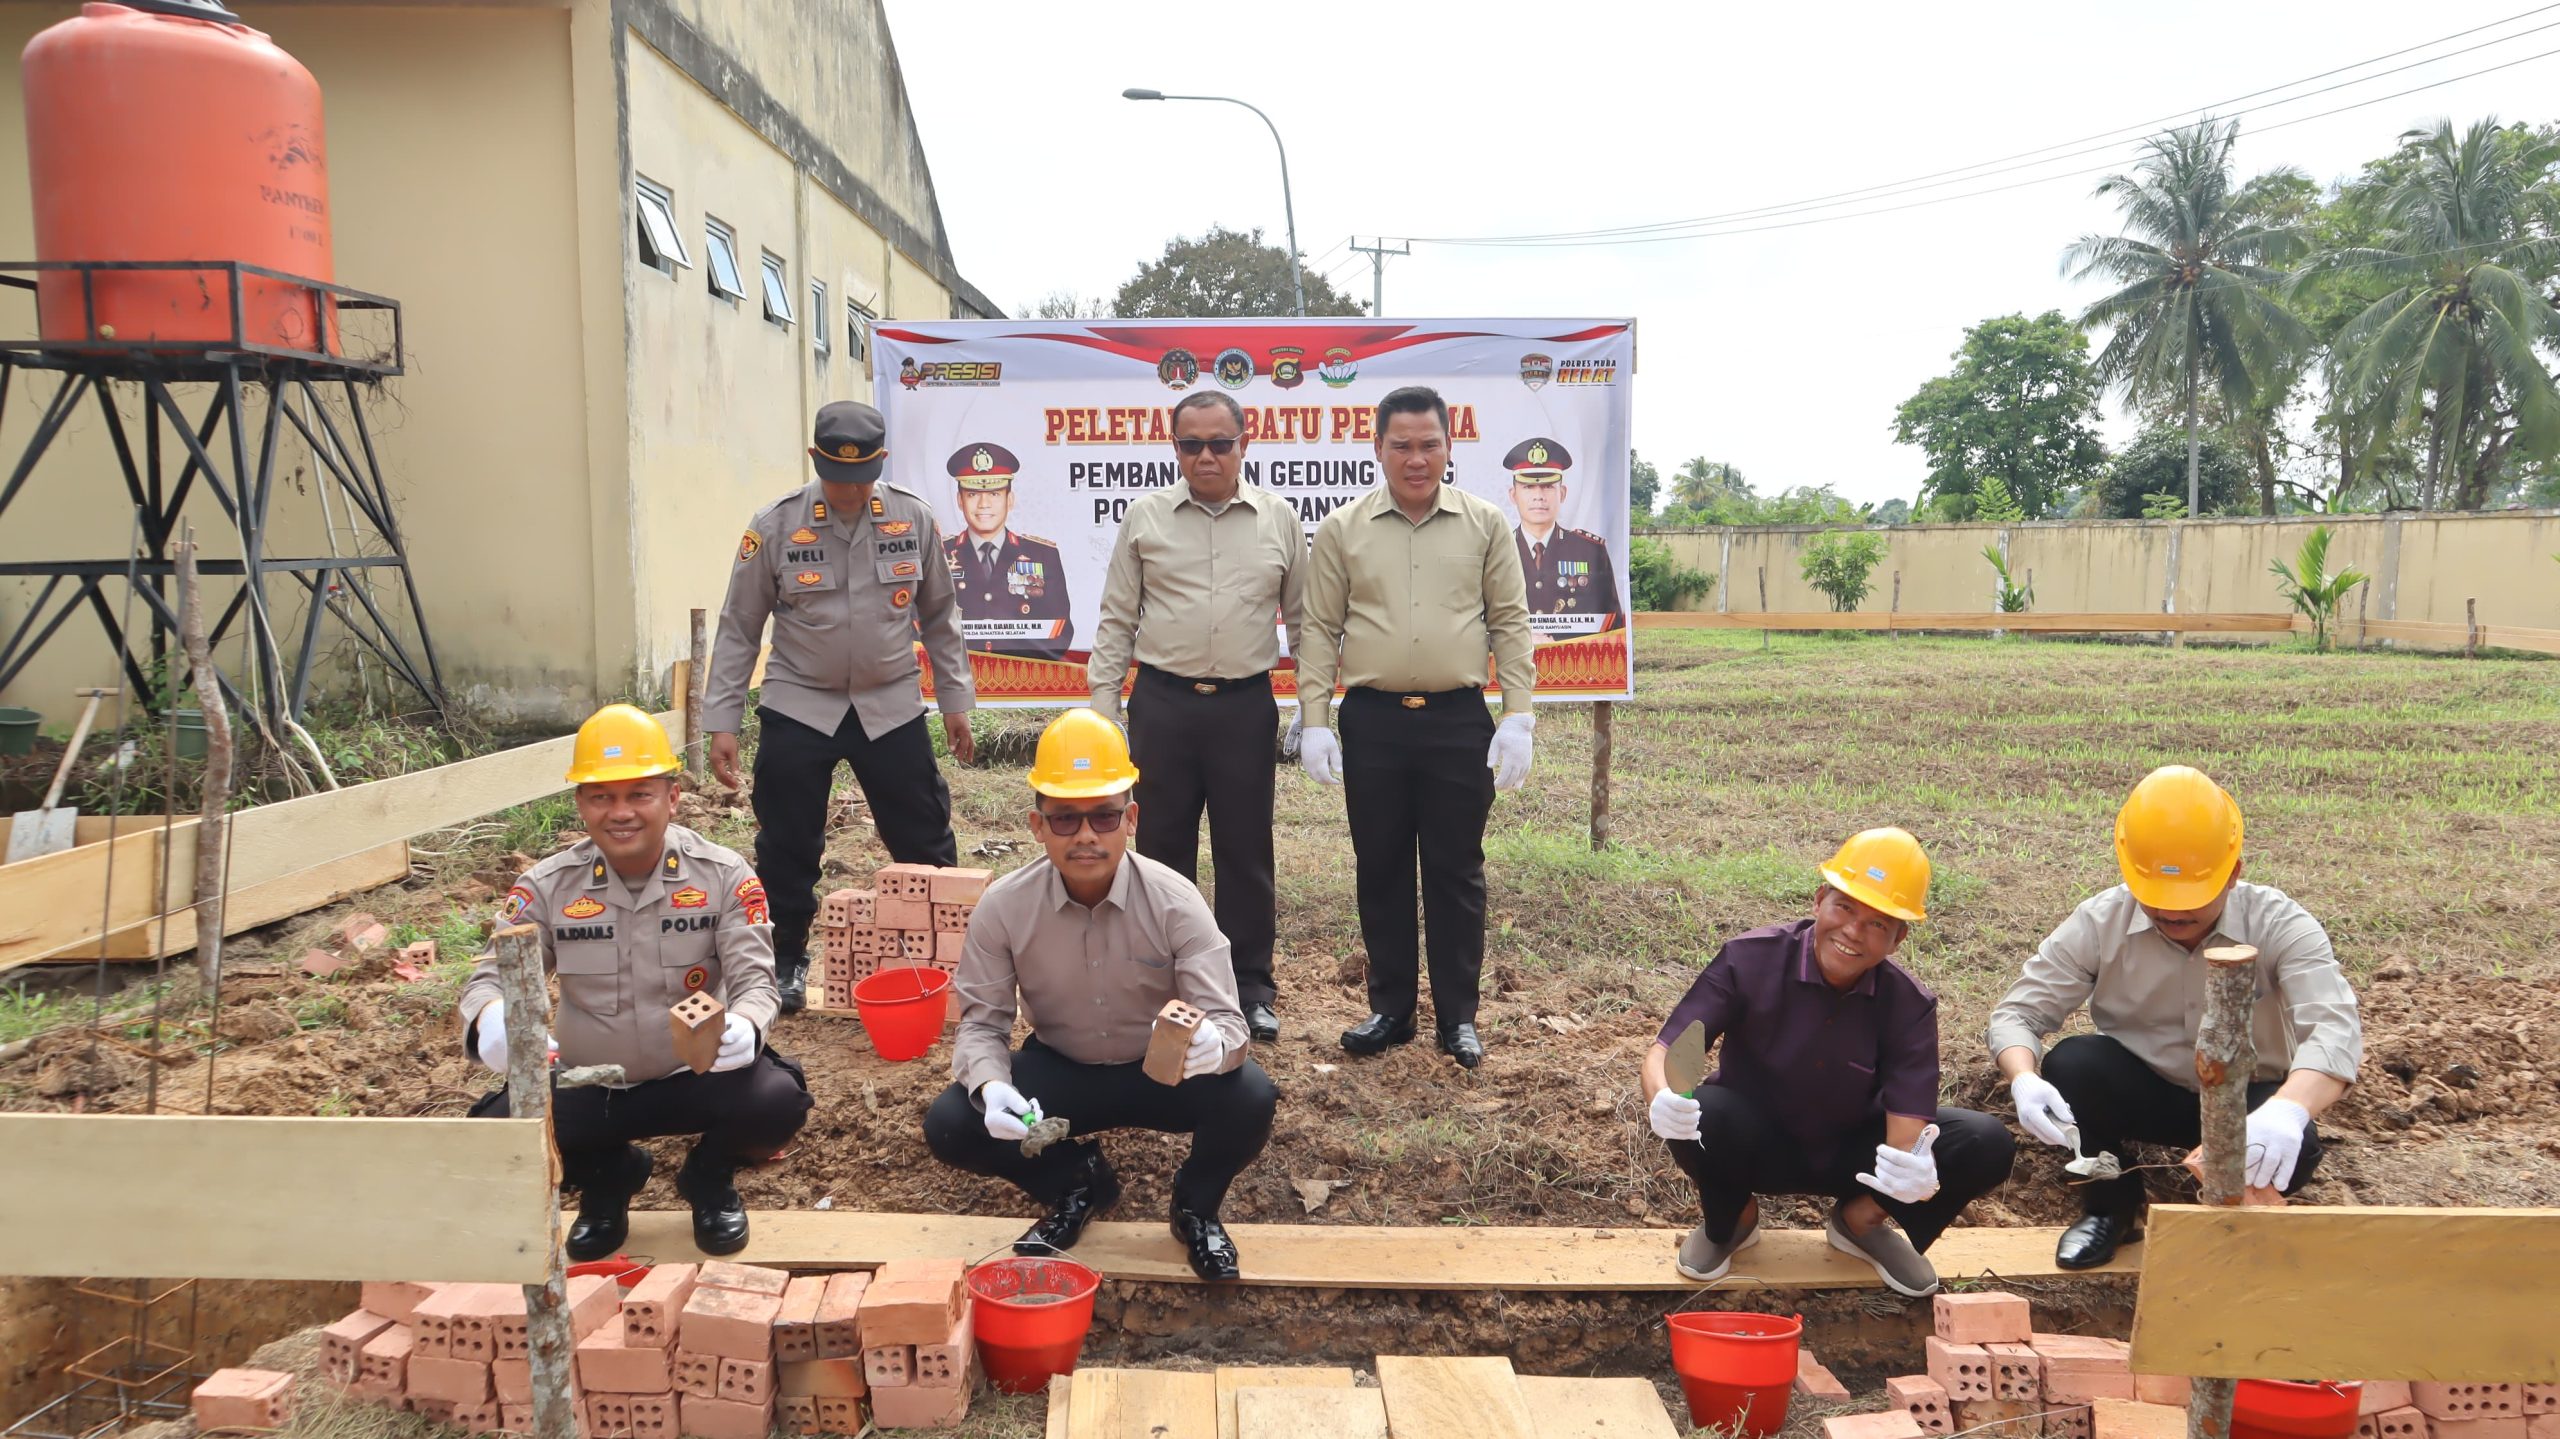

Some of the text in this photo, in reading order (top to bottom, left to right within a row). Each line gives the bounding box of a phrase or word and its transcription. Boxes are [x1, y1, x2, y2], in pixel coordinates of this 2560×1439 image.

[921, 362, 1002, 380] PRESISI
[1560, 358, 1617, 368] POLRES MUBA
[1556, 368, 1616, 384] HEBAT
[1045, 406, 1174, 442] PELETA
[1245, 406, 1322, 441] BATU
[1270, 460, 1375, 487] GEDUNG
[878, 539, 918, 555] POLRI
[787, 549, 824, 564] WELI
[661, 915, 718, 934] POLRI
